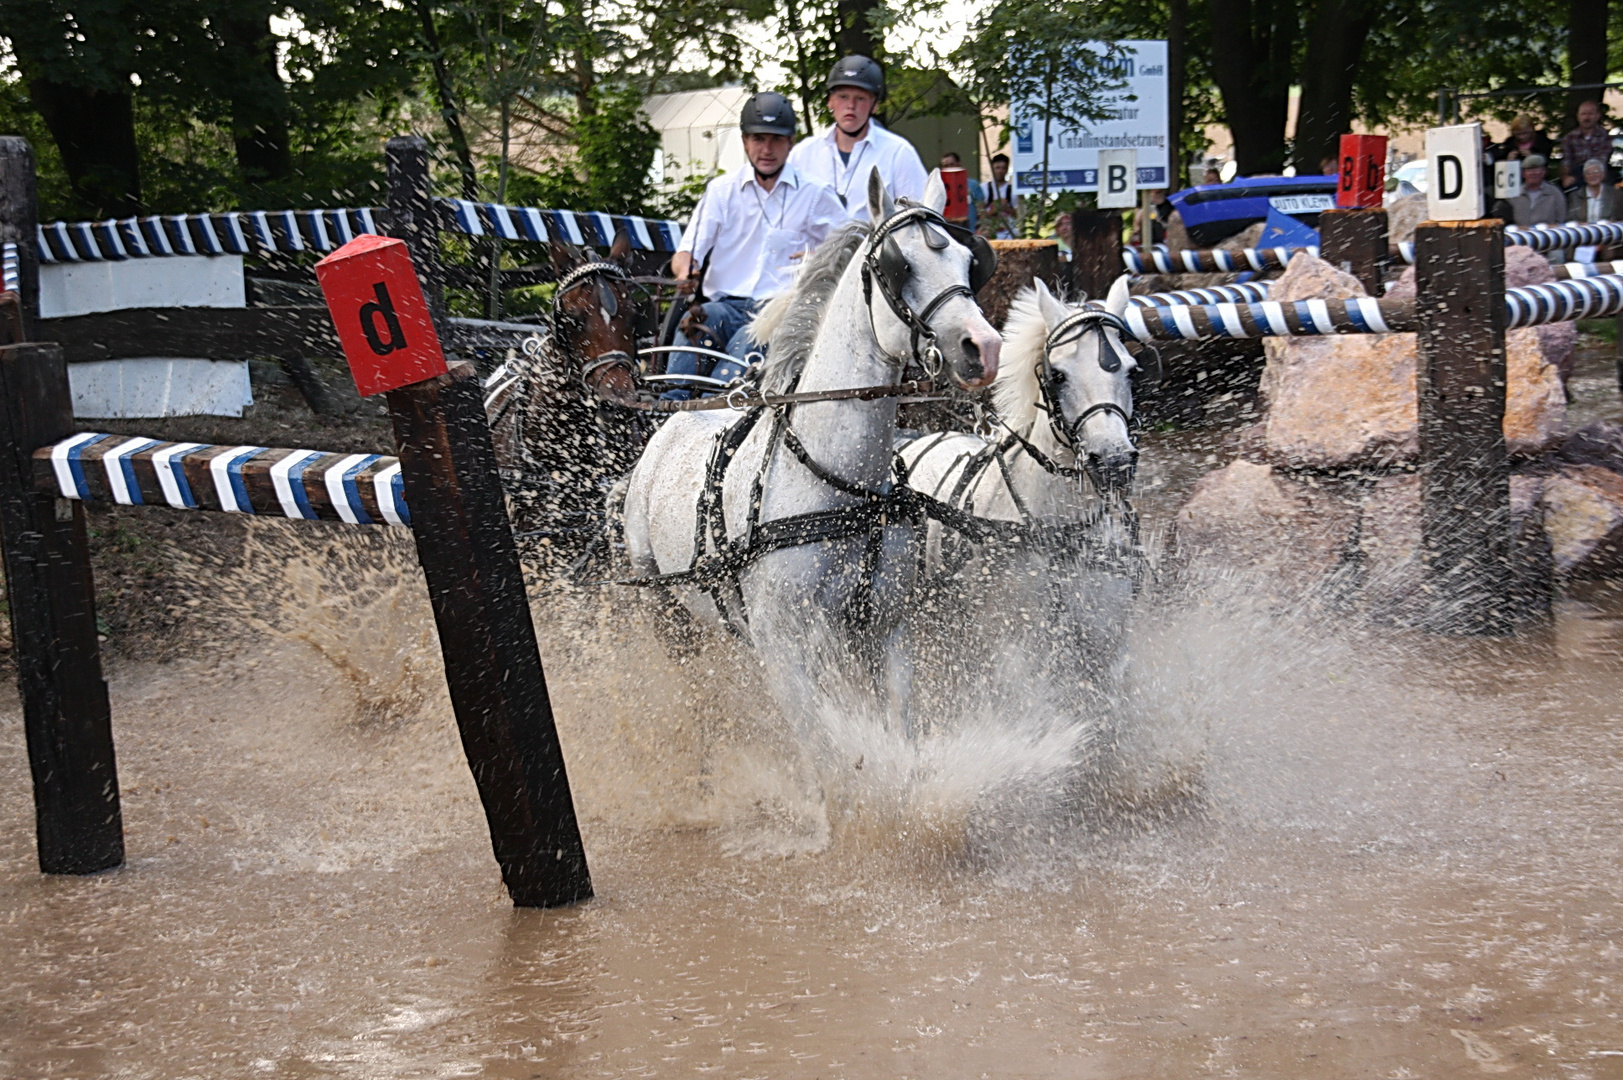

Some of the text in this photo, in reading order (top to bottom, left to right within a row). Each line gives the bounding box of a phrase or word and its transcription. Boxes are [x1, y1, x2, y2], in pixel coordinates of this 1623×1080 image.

[1139, 64, 1164, 76] GmbH
[1107, 165, 1127, 194] B
[1343, 156, 1354, 191] B
[1366, 154, 1379, 191] b
[1437, 155, 1463, 200] D
[1496, 170, 1504, 188] C
[1273, 198, 1299, 210] AUTO
[359, 281, 408, 356] d
